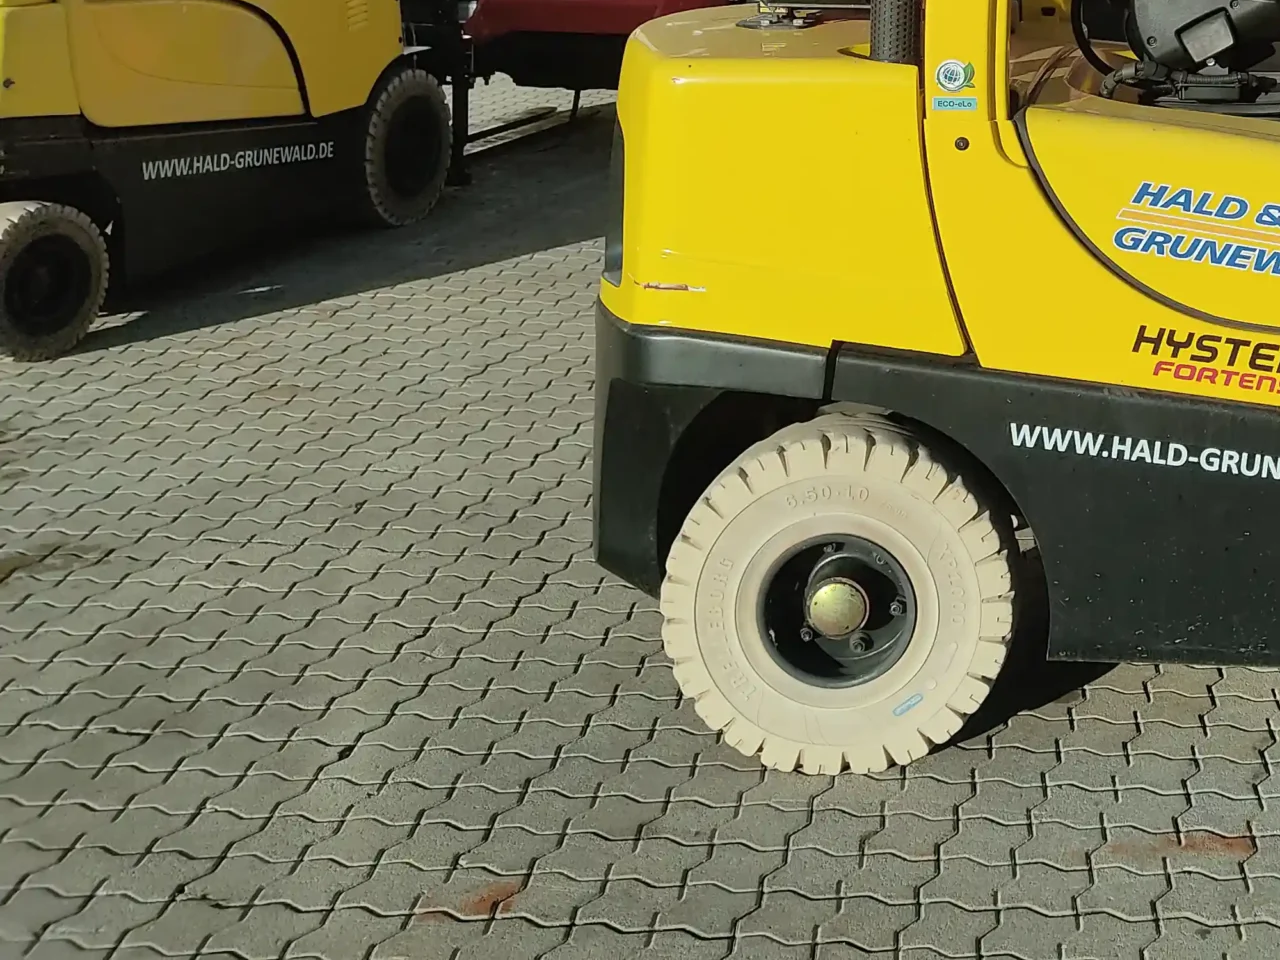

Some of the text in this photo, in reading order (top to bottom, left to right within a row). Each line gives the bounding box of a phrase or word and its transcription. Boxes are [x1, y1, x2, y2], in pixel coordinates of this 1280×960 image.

[937, 100, 973, 108] ECO-eLo
[142, 141, 335, 181] WWW.HALD-GRUNEWALD.DE
[1130, 181, 1249, 220] HALD
